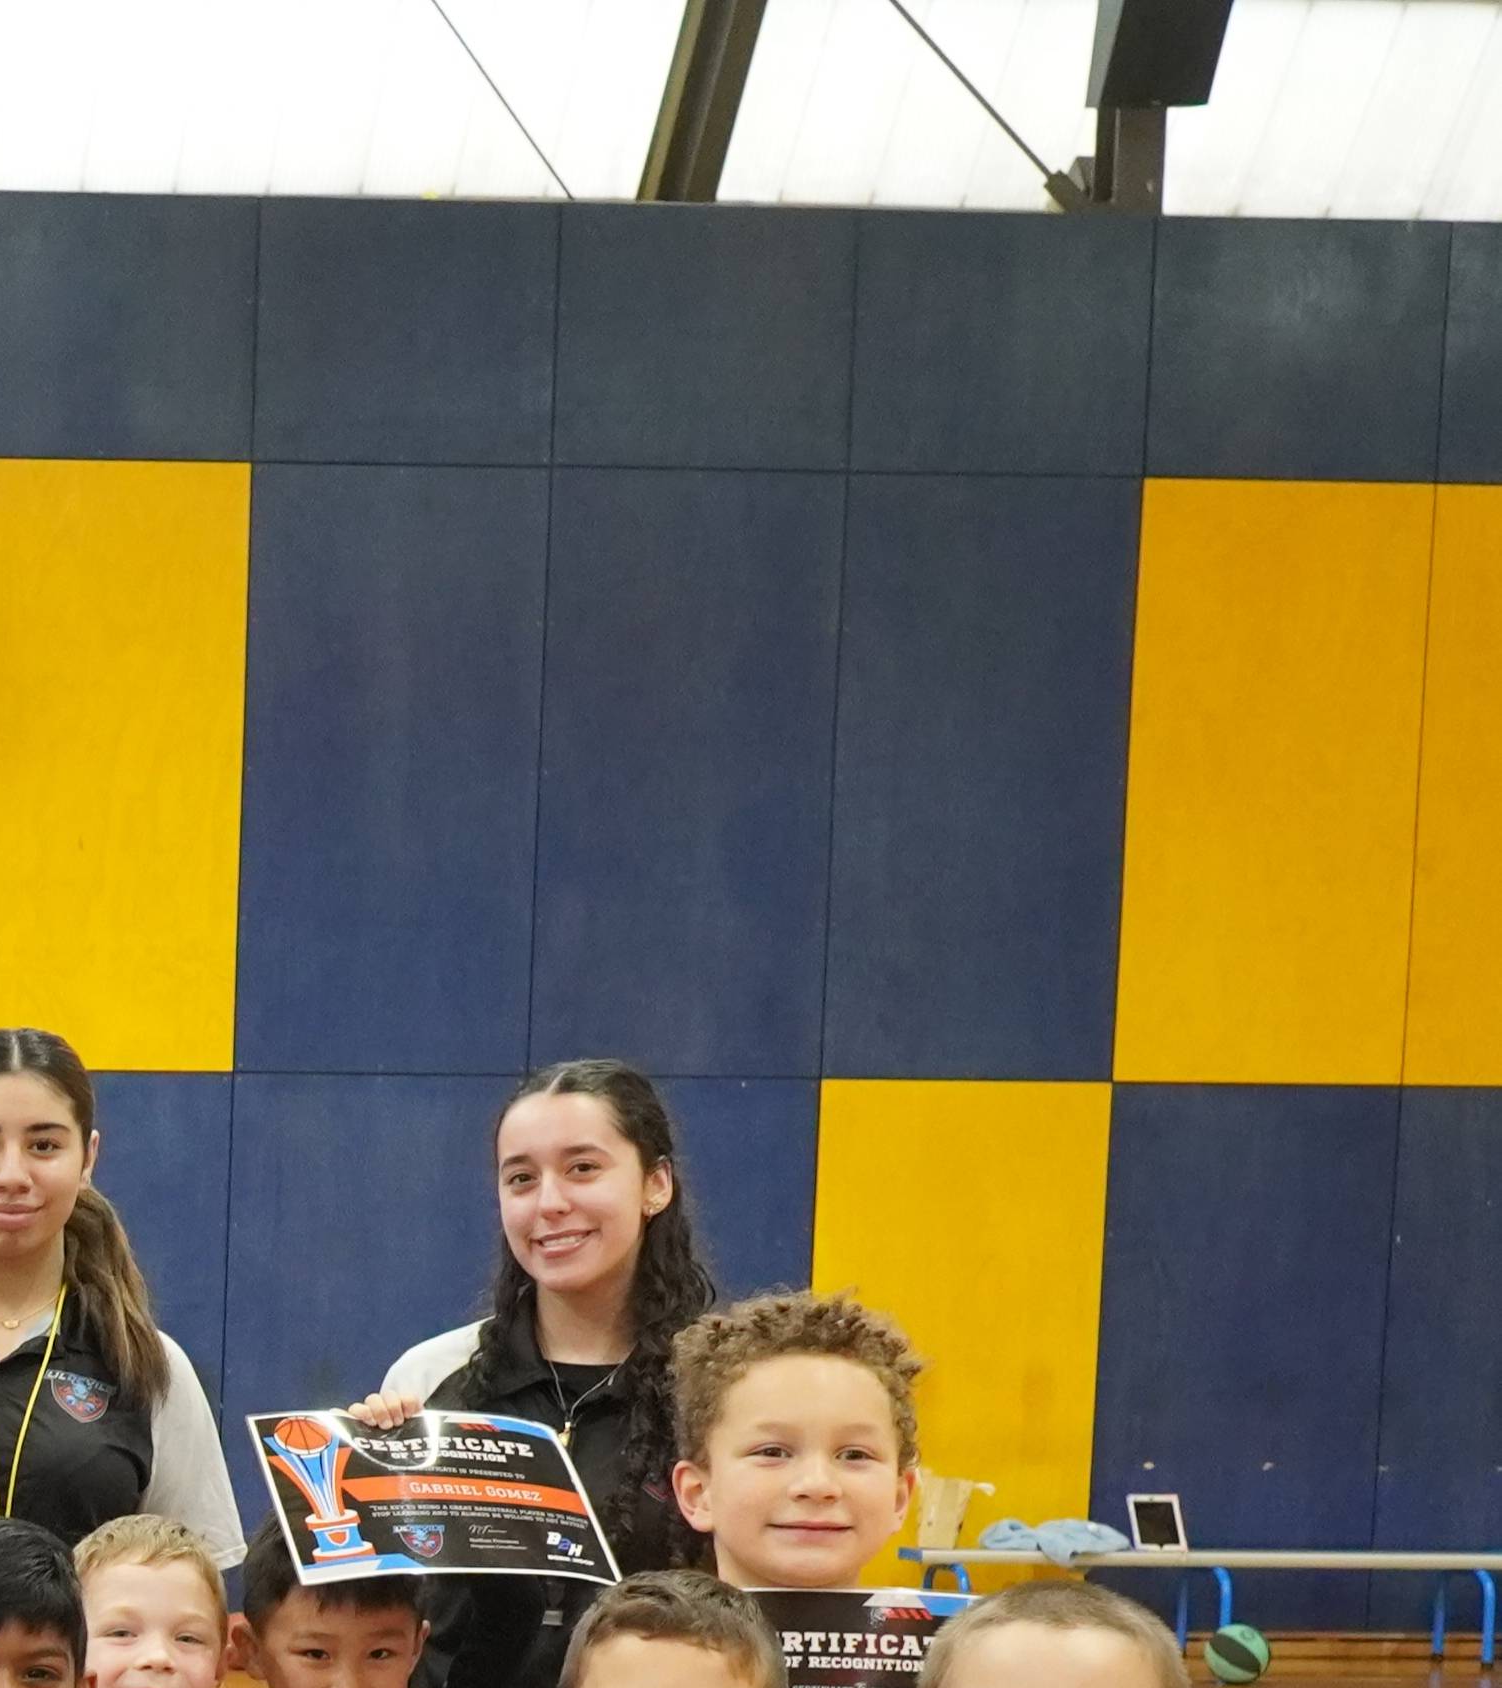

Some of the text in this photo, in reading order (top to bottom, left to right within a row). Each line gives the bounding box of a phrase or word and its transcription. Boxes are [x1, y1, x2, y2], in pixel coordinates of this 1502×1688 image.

[359, 1437, 534, 1458] CERTIFICATE
[409, 1482, 542, 1502] GABRIEL GOMEZ
[783, 1630, 934, 1657] RTIFICAT
[808, 1656, 926, 1673] RECOGNITION
